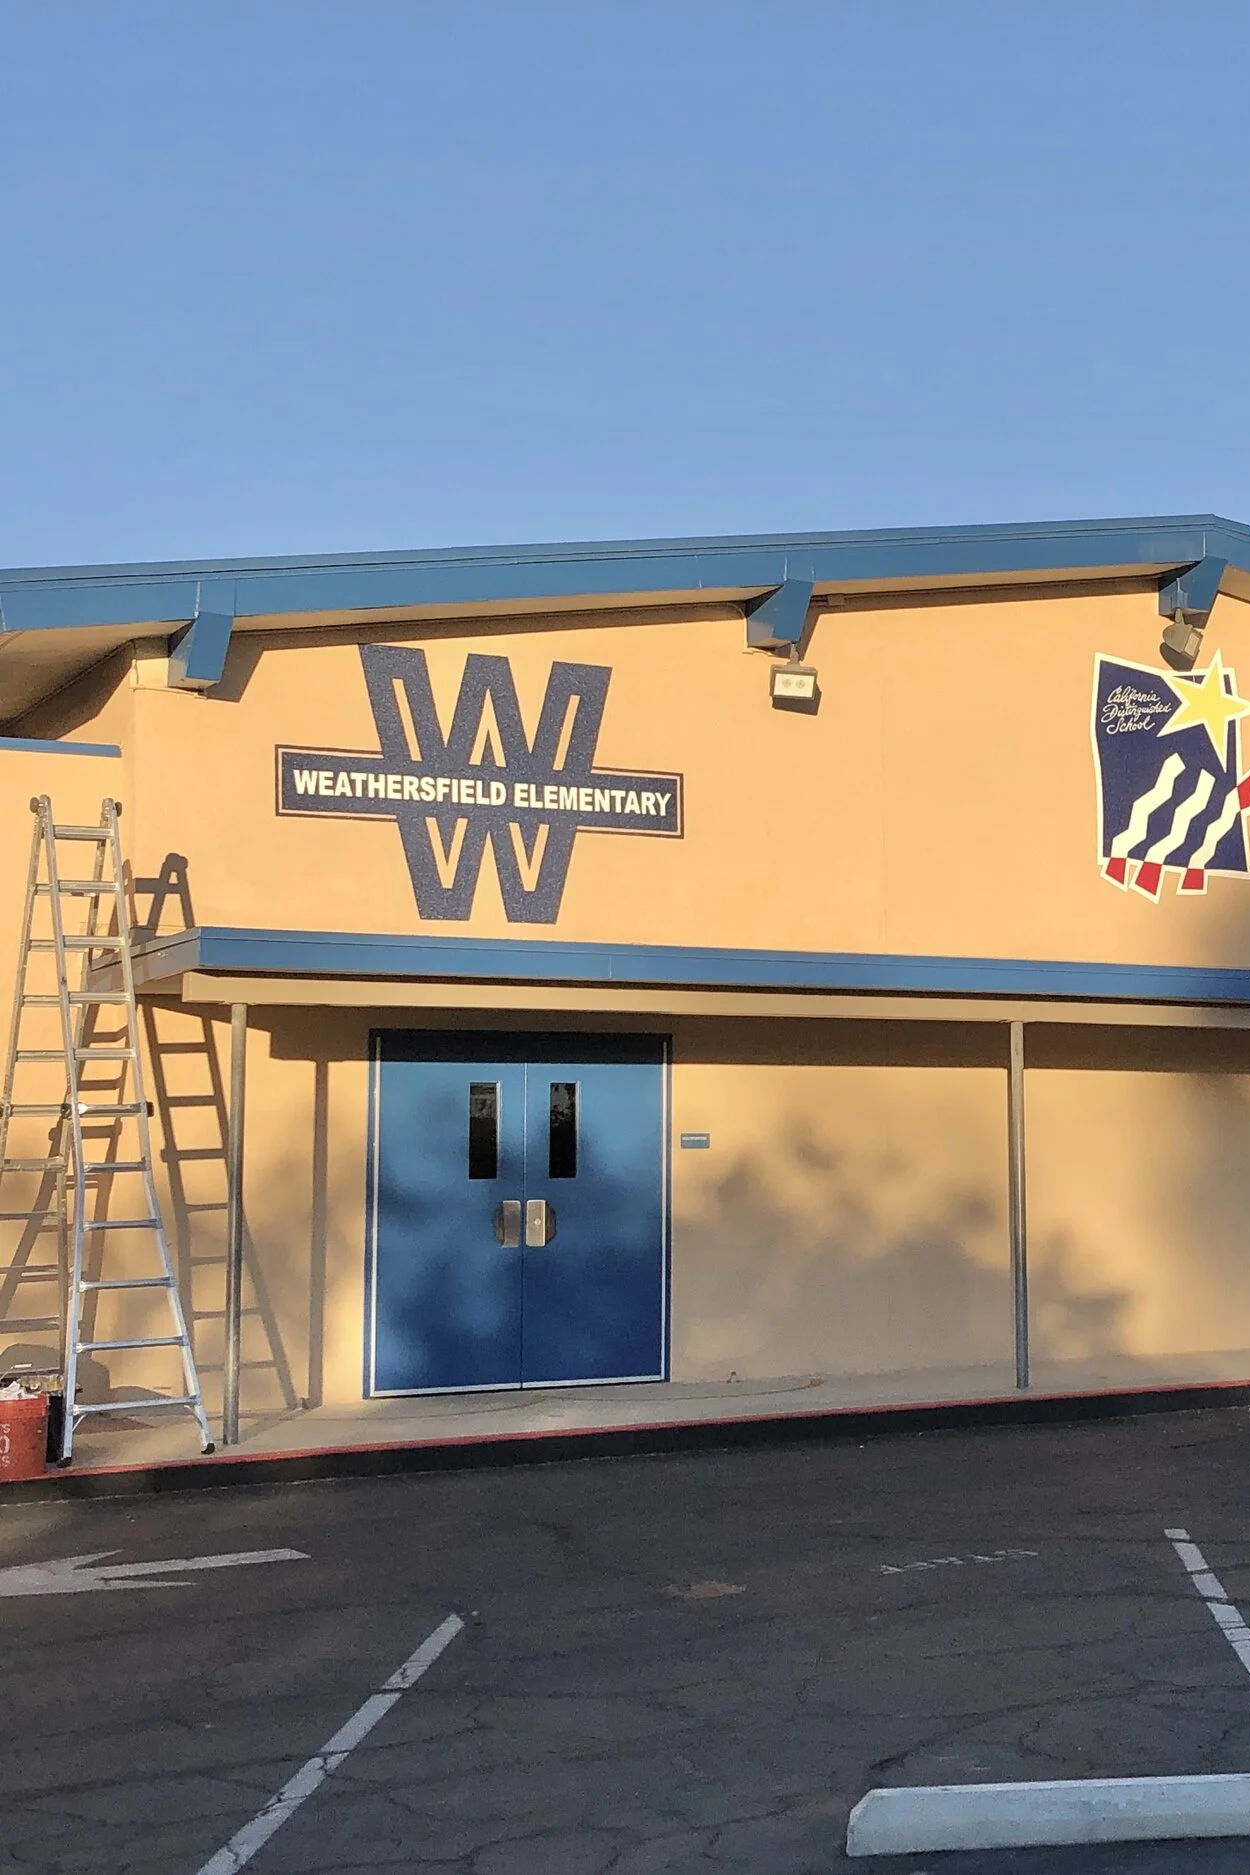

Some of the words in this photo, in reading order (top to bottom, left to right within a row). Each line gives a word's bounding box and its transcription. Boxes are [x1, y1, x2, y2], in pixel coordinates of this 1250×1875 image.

[1107, 685, 1161, 707] California
[1101, 702, 1172, 723] Distinguished
[1106, 715, 1156, 735] School
[293, 769, 507, 807] WEATHERSFIELD
[514, 782, 672, 817] ELEMENTARY
